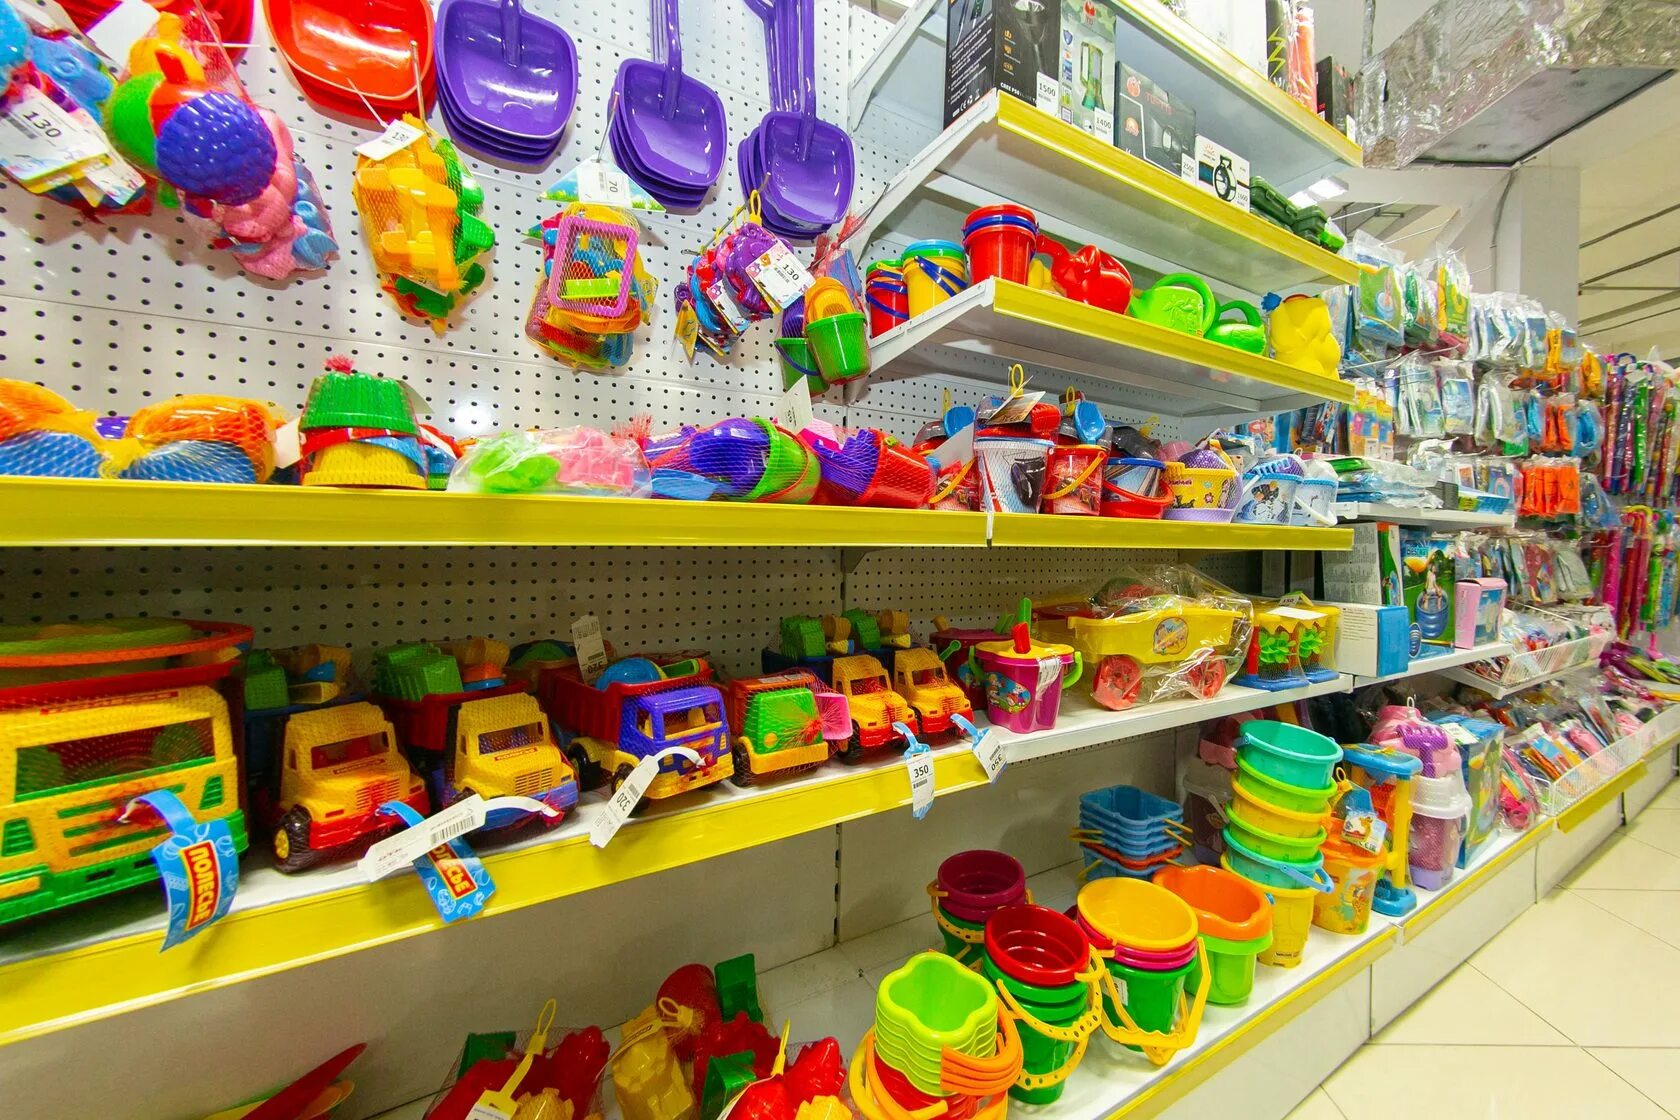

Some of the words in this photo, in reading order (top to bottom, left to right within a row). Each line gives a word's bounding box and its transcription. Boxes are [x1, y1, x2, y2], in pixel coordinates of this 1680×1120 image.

[1039, 83, 1056, 97] 1500
[23, 111, 62, 138] 130
[1096, 117, 1112, 130] 1400
[609, 180, 619, 193] 70
[782, 263, 800, 281] 130
[991, 753, 1003, 771] 350
[913, 764, 929, 779] 350
[616, 792, 631, 812] 320
[188, 846, 215, 923] ПОЛЕСЬЕ
